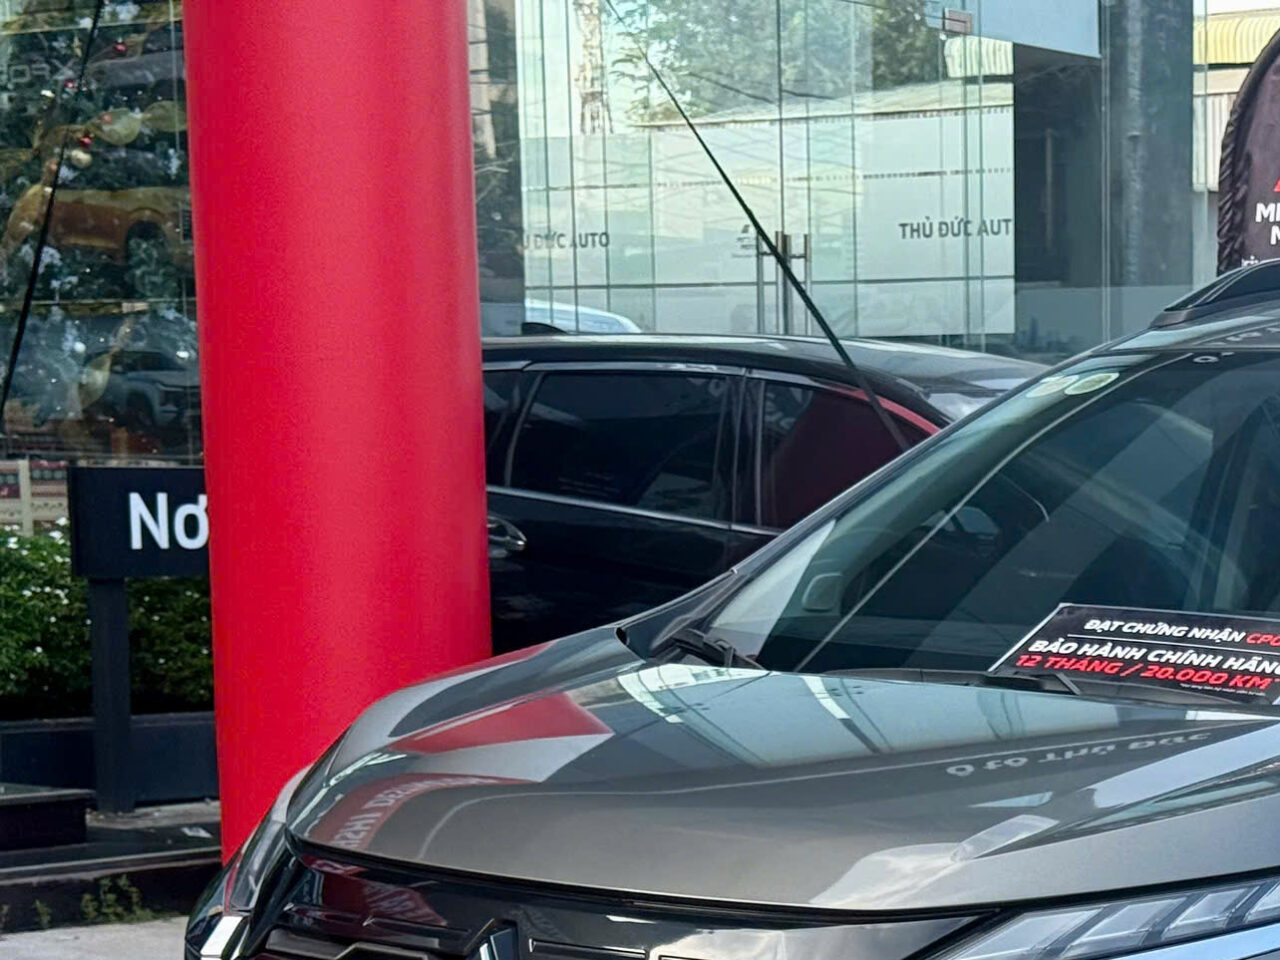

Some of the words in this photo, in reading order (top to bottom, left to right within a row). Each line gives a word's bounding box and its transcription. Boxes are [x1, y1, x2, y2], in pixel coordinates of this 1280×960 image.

[899, 216, 933, 239] THỦ
[1084, 619, 1123, 634] ĐẠT
[1121, 620, 1189, 637] CHỨNG
[1188, 626, 1246, 645] NHẬN
[1028, 639, 1078, 654] BẢO
[1077, 640, 1143, 661] HÀNH
[1146, 646, 1222, 668] CHÍNH
[1015, 655, 1038, 668] 12
[1044, 655, 1120, 676] THÁNG
[1139, 666, 1227, 685] 20.000
